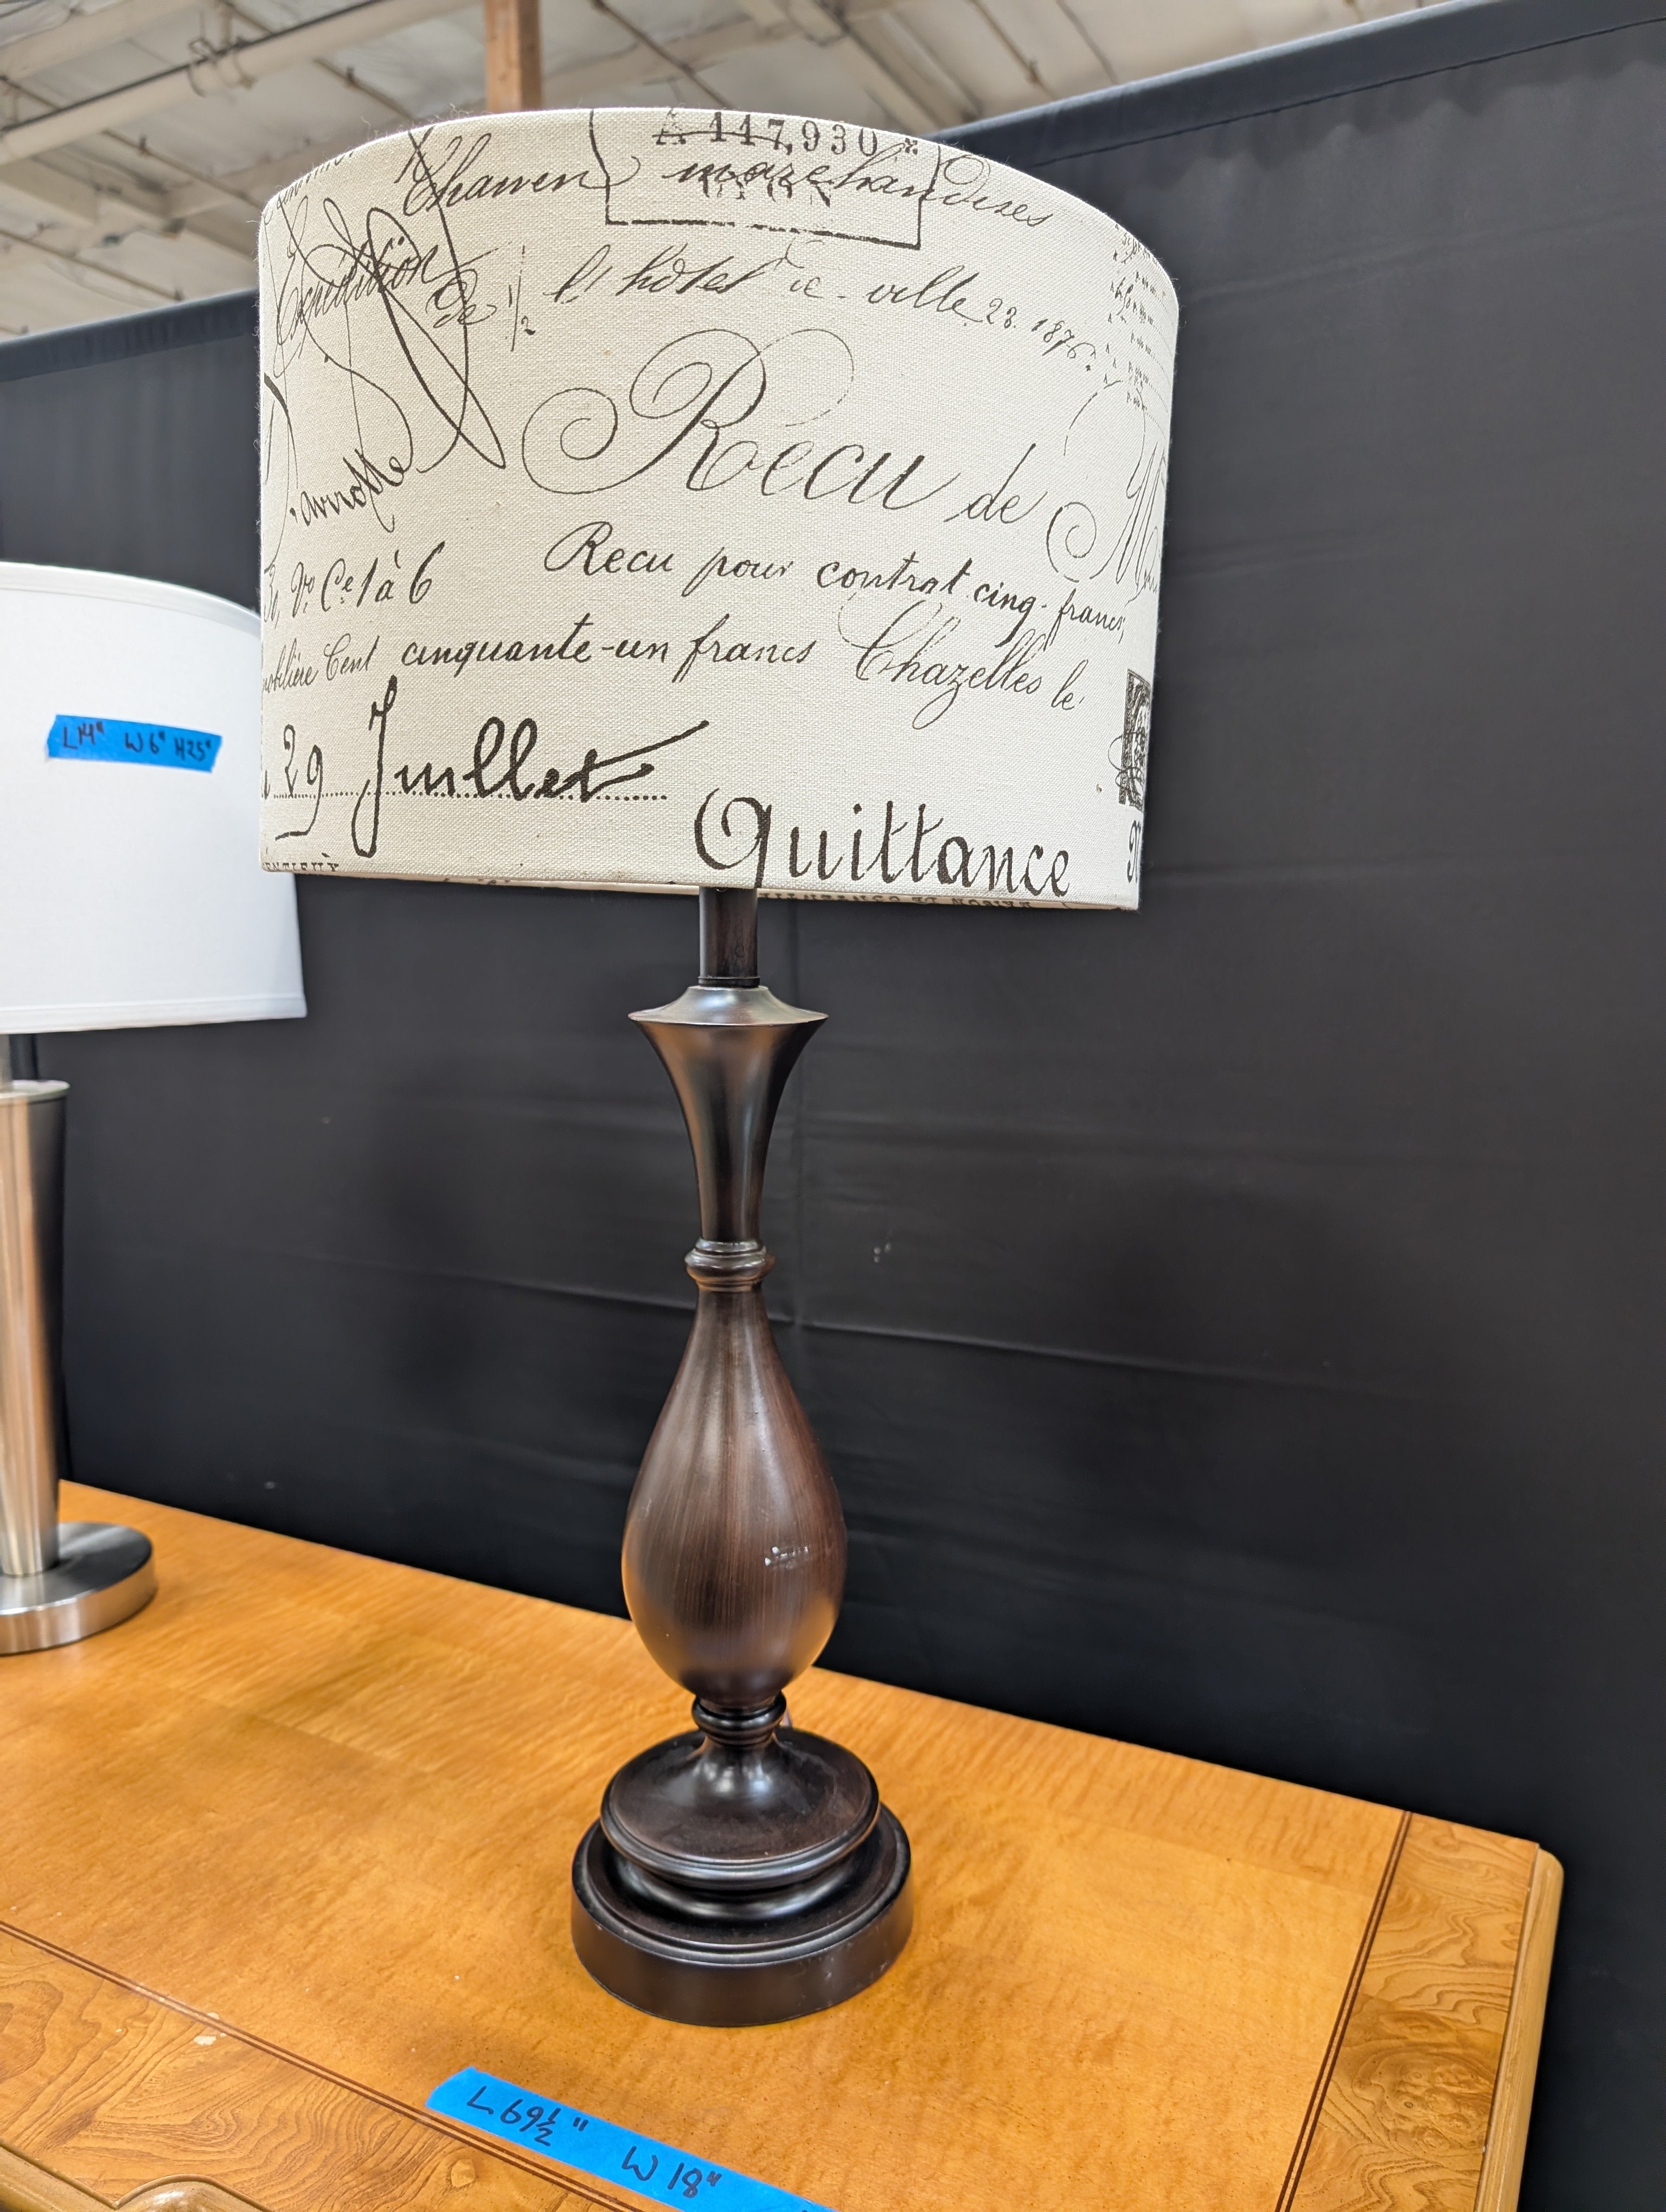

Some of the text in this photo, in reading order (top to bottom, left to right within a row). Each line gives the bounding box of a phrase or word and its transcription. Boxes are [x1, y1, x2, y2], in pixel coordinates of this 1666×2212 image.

[681, 546, 793, 598] pour
[672, 613, 817, 683] francs
[620, 2145, 659, 2182] W
